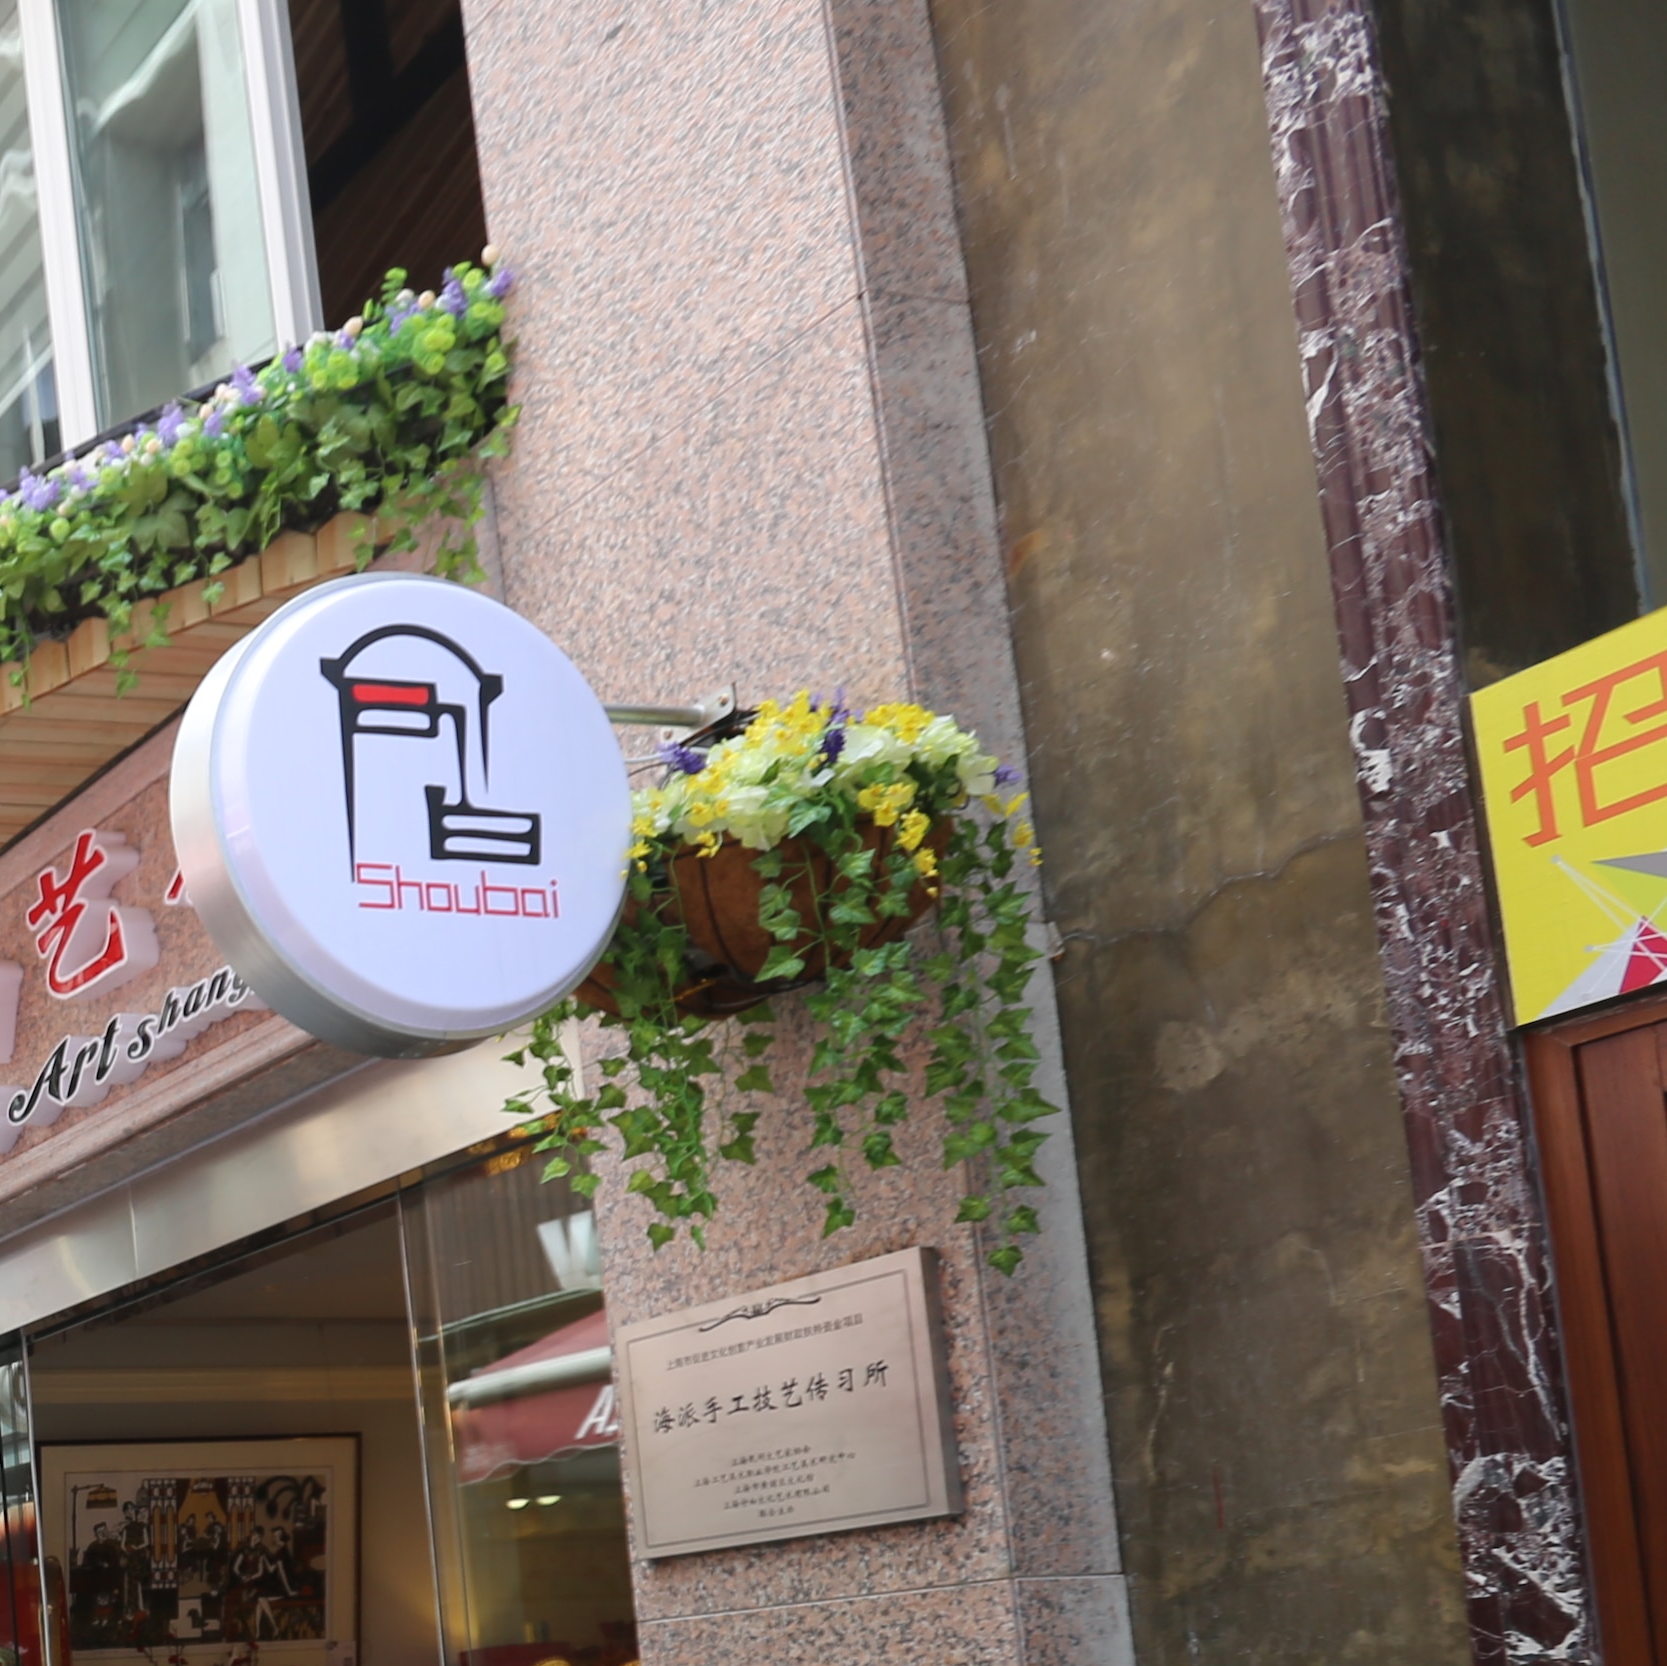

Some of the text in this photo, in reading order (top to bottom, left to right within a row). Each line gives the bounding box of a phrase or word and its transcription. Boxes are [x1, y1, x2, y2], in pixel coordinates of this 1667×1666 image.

[1503, 650, 1667, 848] 招
[356, 863, 559, 918] Shoubai
[8, 1013, 123, 1124] Art
[126, 964, 257, 1063] shang
[653, 1359, 890, 1434] 海派手工技艺传习所
